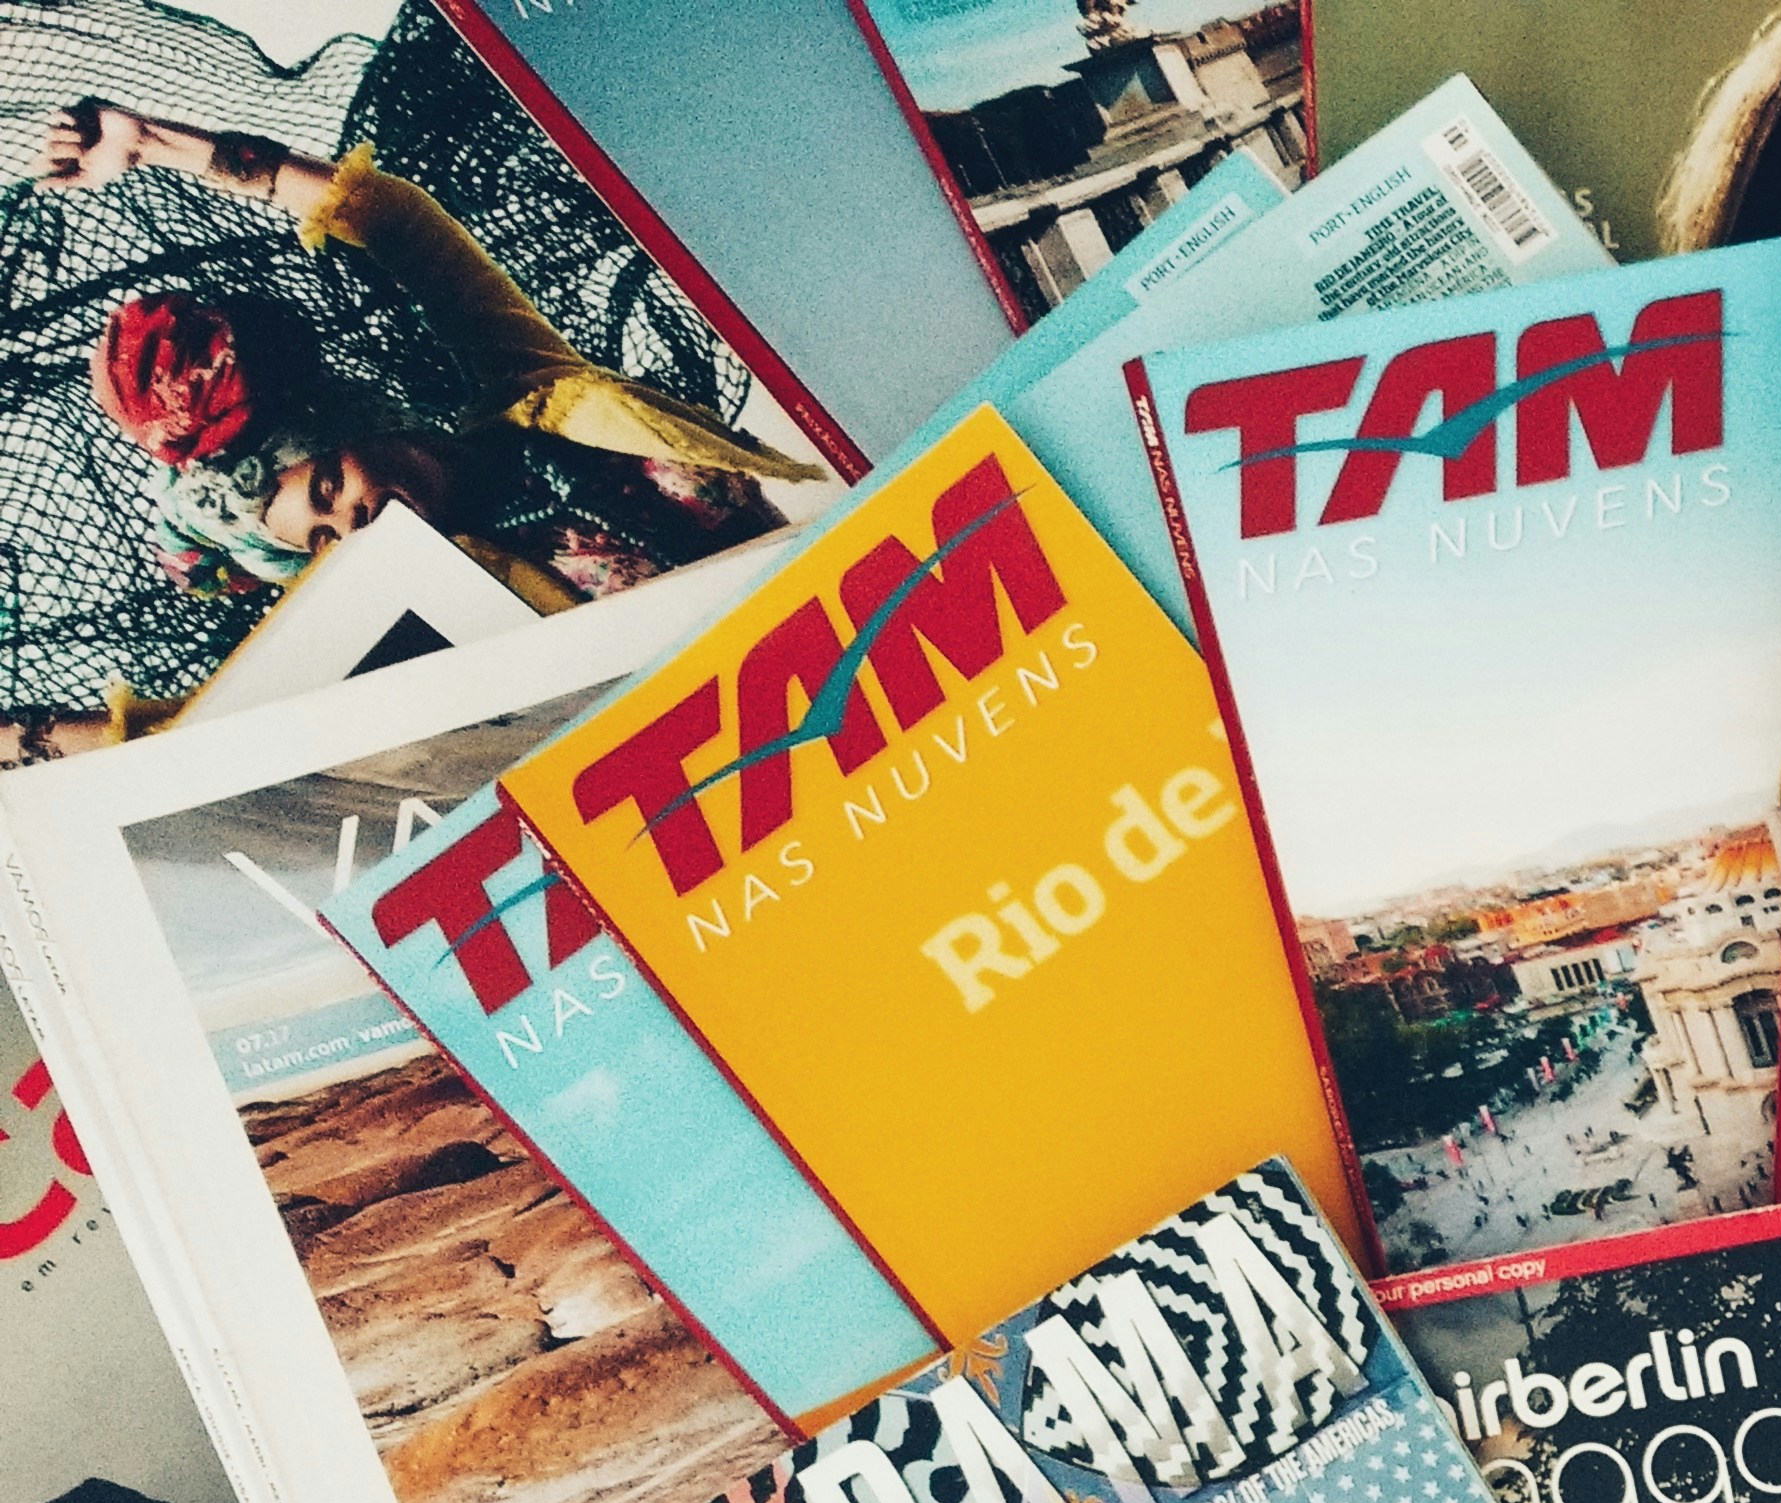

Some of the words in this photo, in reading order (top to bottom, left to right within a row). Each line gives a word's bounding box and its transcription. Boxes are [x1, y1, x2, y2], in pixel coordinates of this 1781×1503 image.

[1184, 290, 1725, 541] TAM
[1237, 538, 1380, 601] NAS
[1430, 464, 1733, 565] NUVENS
[572, 452, 1067, 898] TAM
[684, 841, 814, 952] NAS
[844, 623, 1099, 840] NUVENS
[920, 860, 1105, 1013] Rio
[1105, 763, 1238, 884] de
[494, 956, 626, 1071] NAS
[1410, 1264, 1493, 1300] personal
[1498, 1257, 1547, 1285] copy
[1440, 1328, 1758, 1441] irberlin
